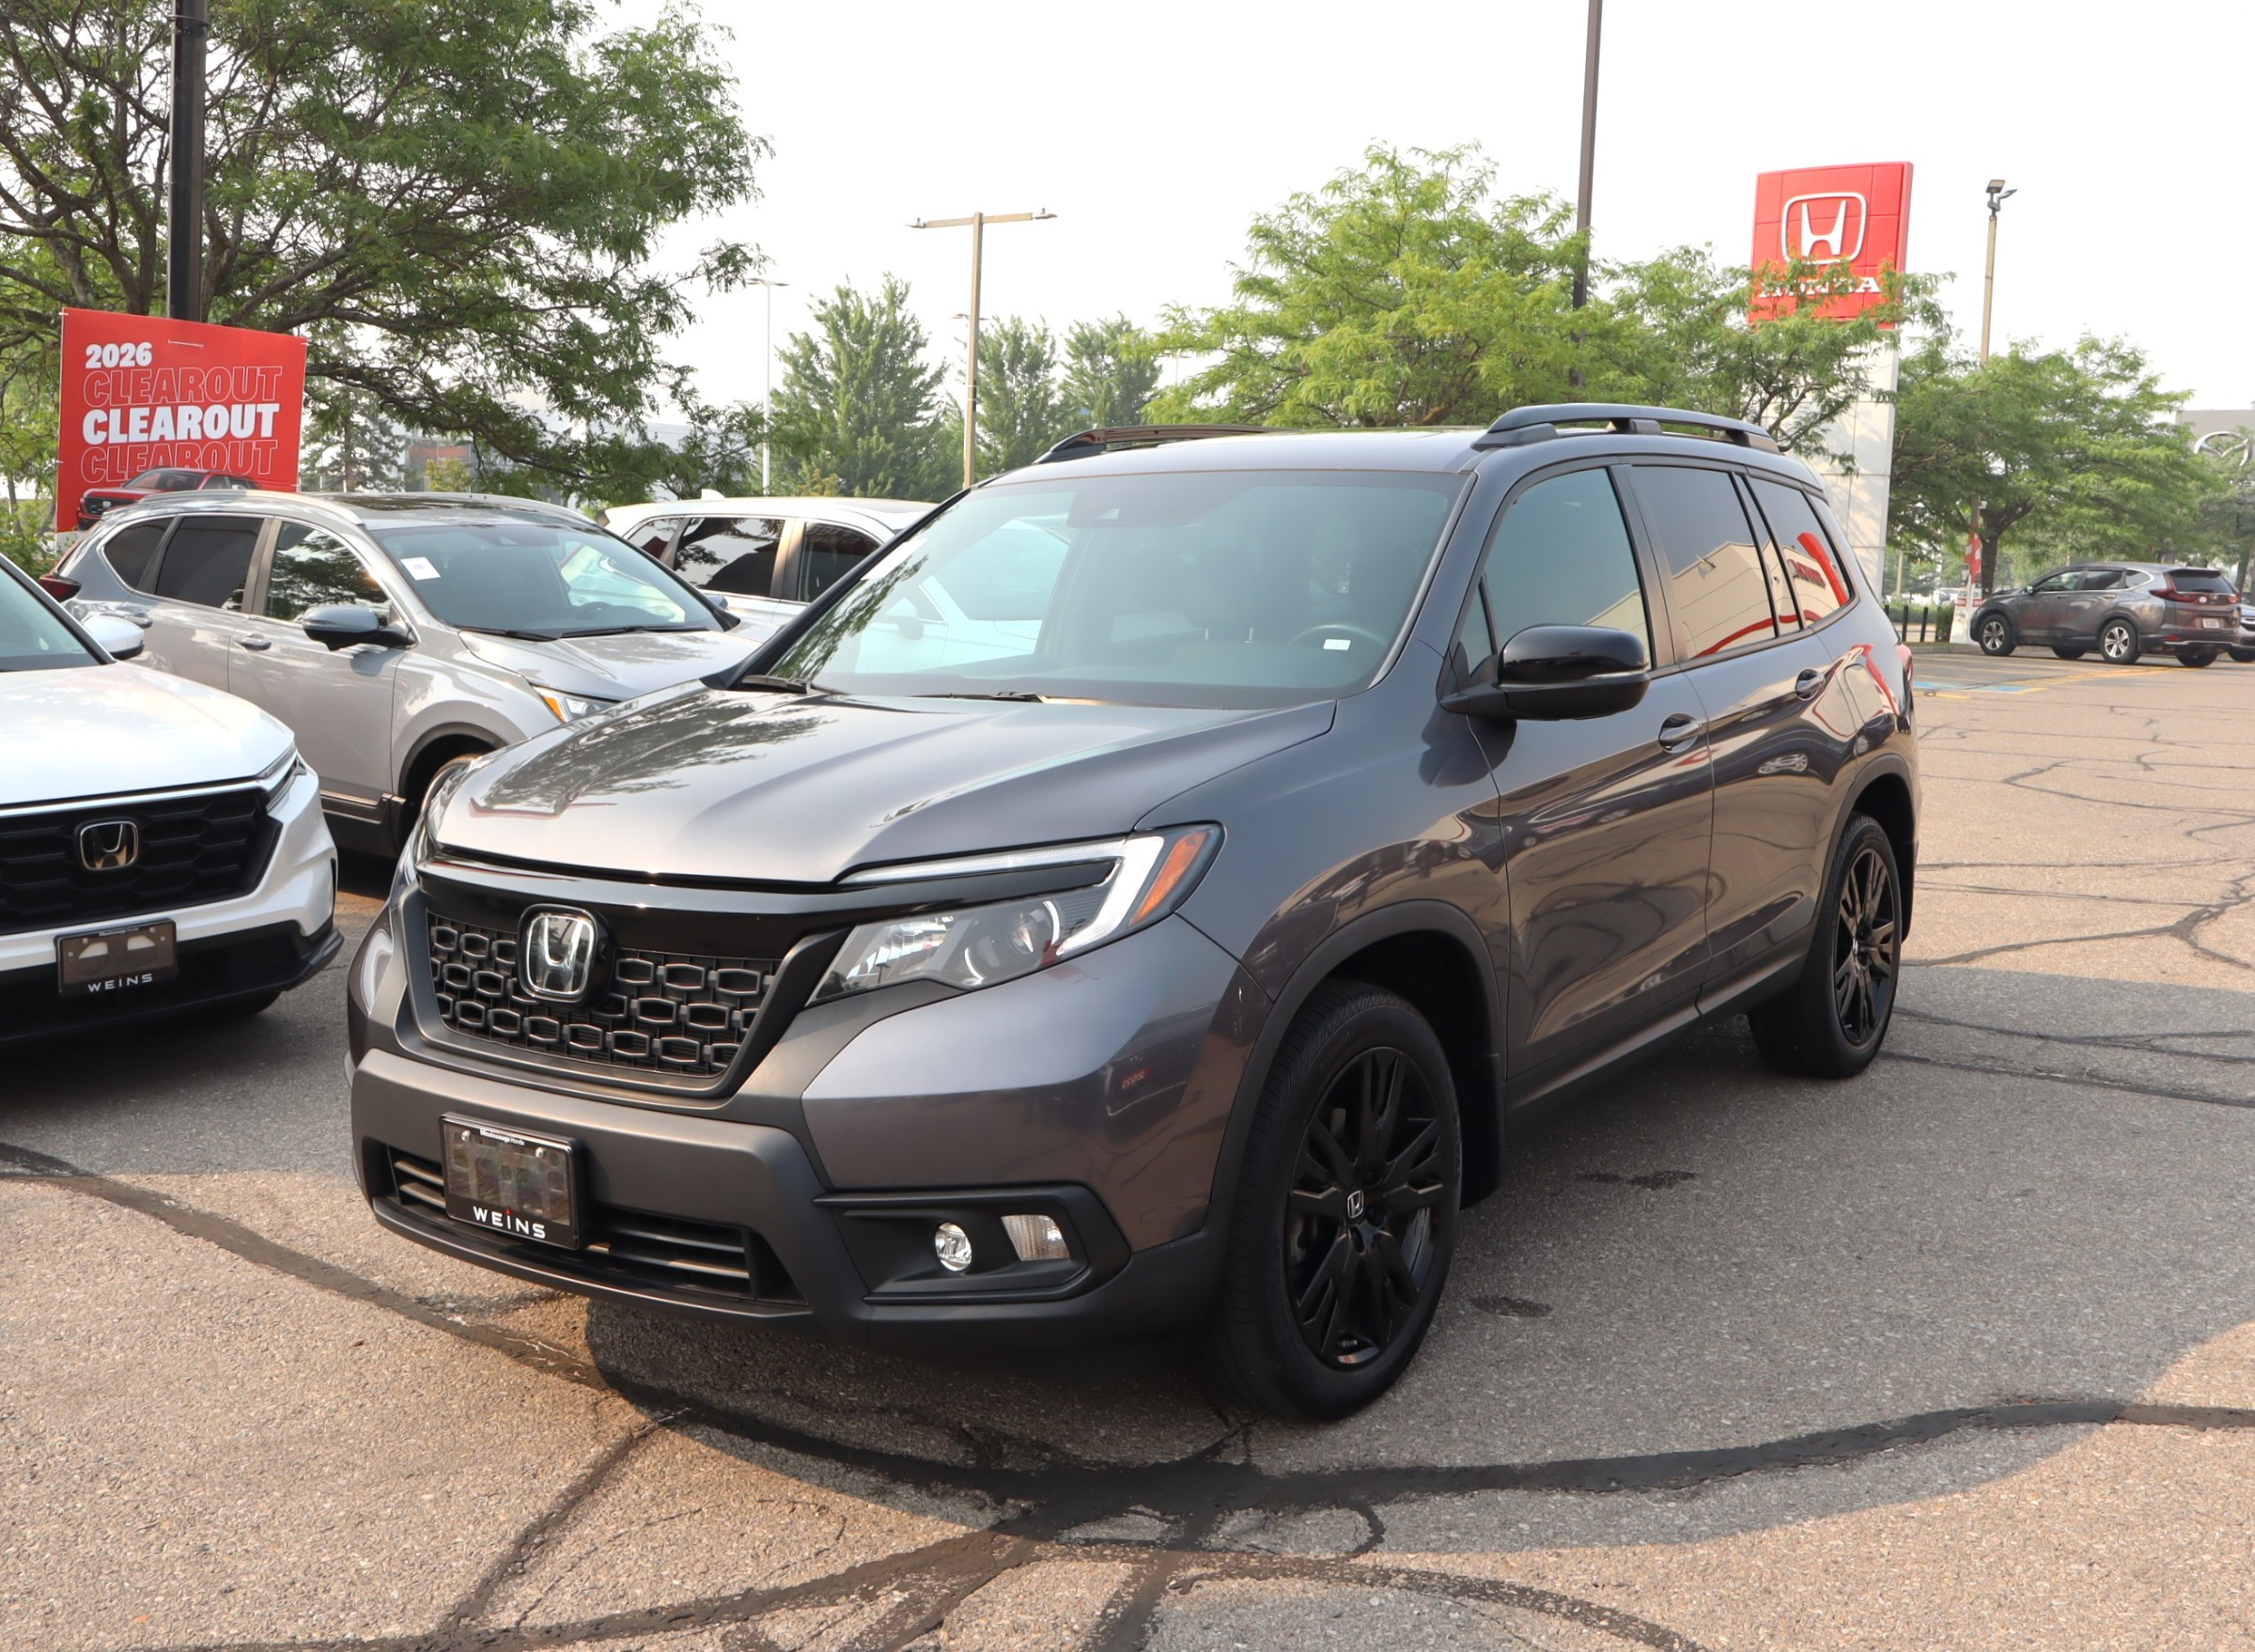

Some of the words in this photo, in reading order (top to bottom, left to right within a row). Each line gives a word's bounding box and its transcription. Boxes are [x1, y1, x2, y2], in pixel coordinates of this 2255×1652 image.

[85, 341, 153, 369] 2026
[83, 366, 283, 408] CLEAROUT
[82, 403, 280, 445] CLEAROUT
[87, 973, 153, 993] WEINS
